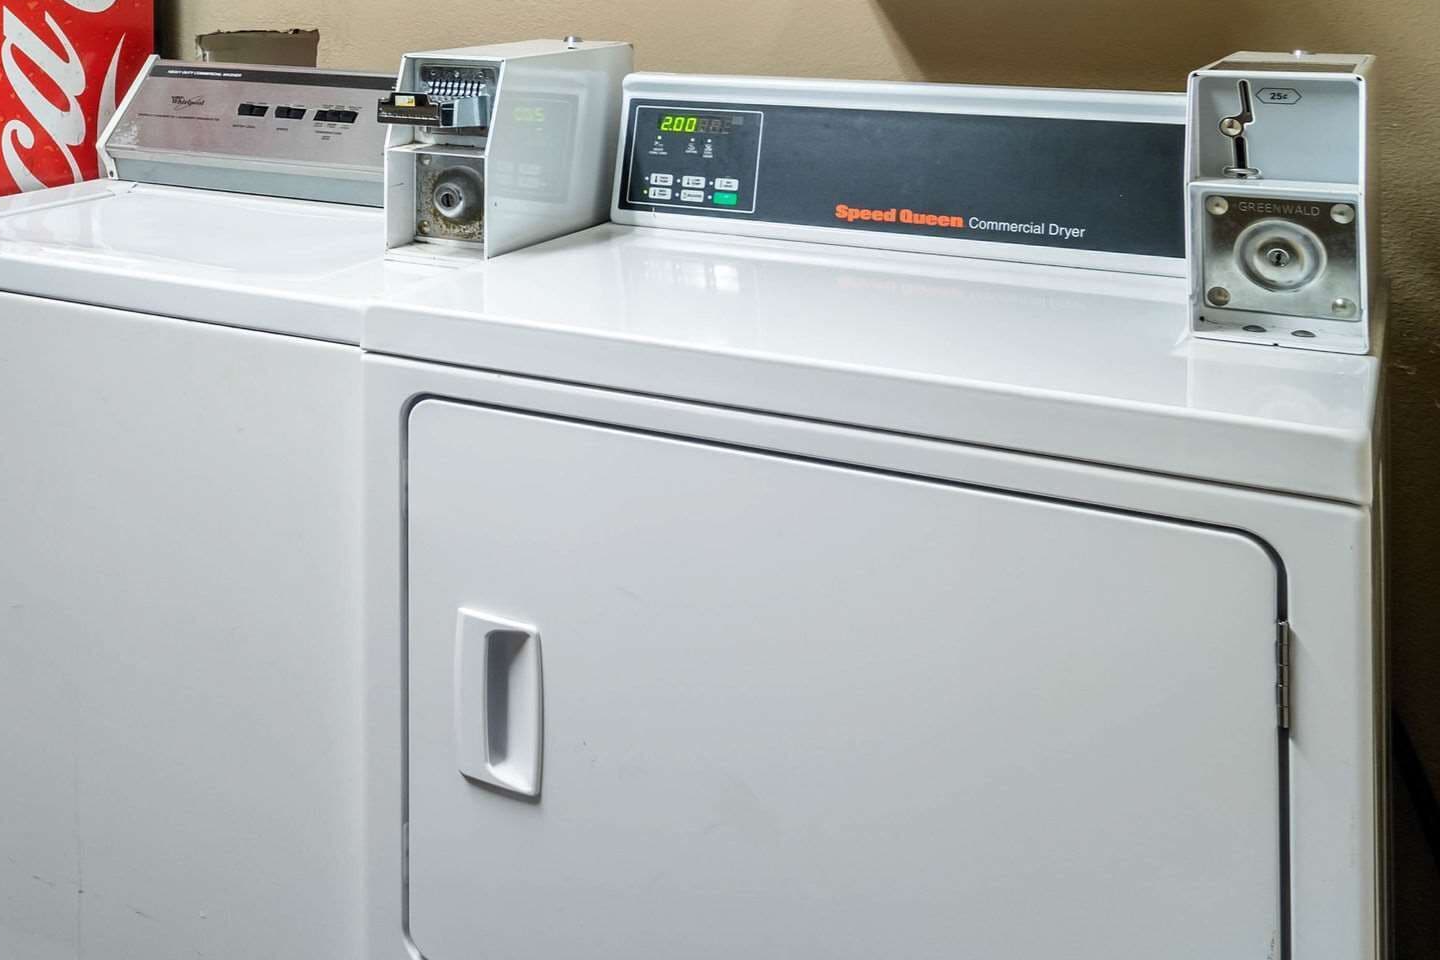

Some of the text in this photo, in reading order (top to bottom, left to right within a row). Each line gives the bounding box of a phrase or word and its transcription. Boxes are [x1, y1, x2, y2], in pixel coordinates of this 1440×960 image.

[661, 116, 697, 132] 2.00
[1238, 201, 1320, 216] GREENWALD
[835, 204, 1086, 240] Speed Queen Commercial Dryer
